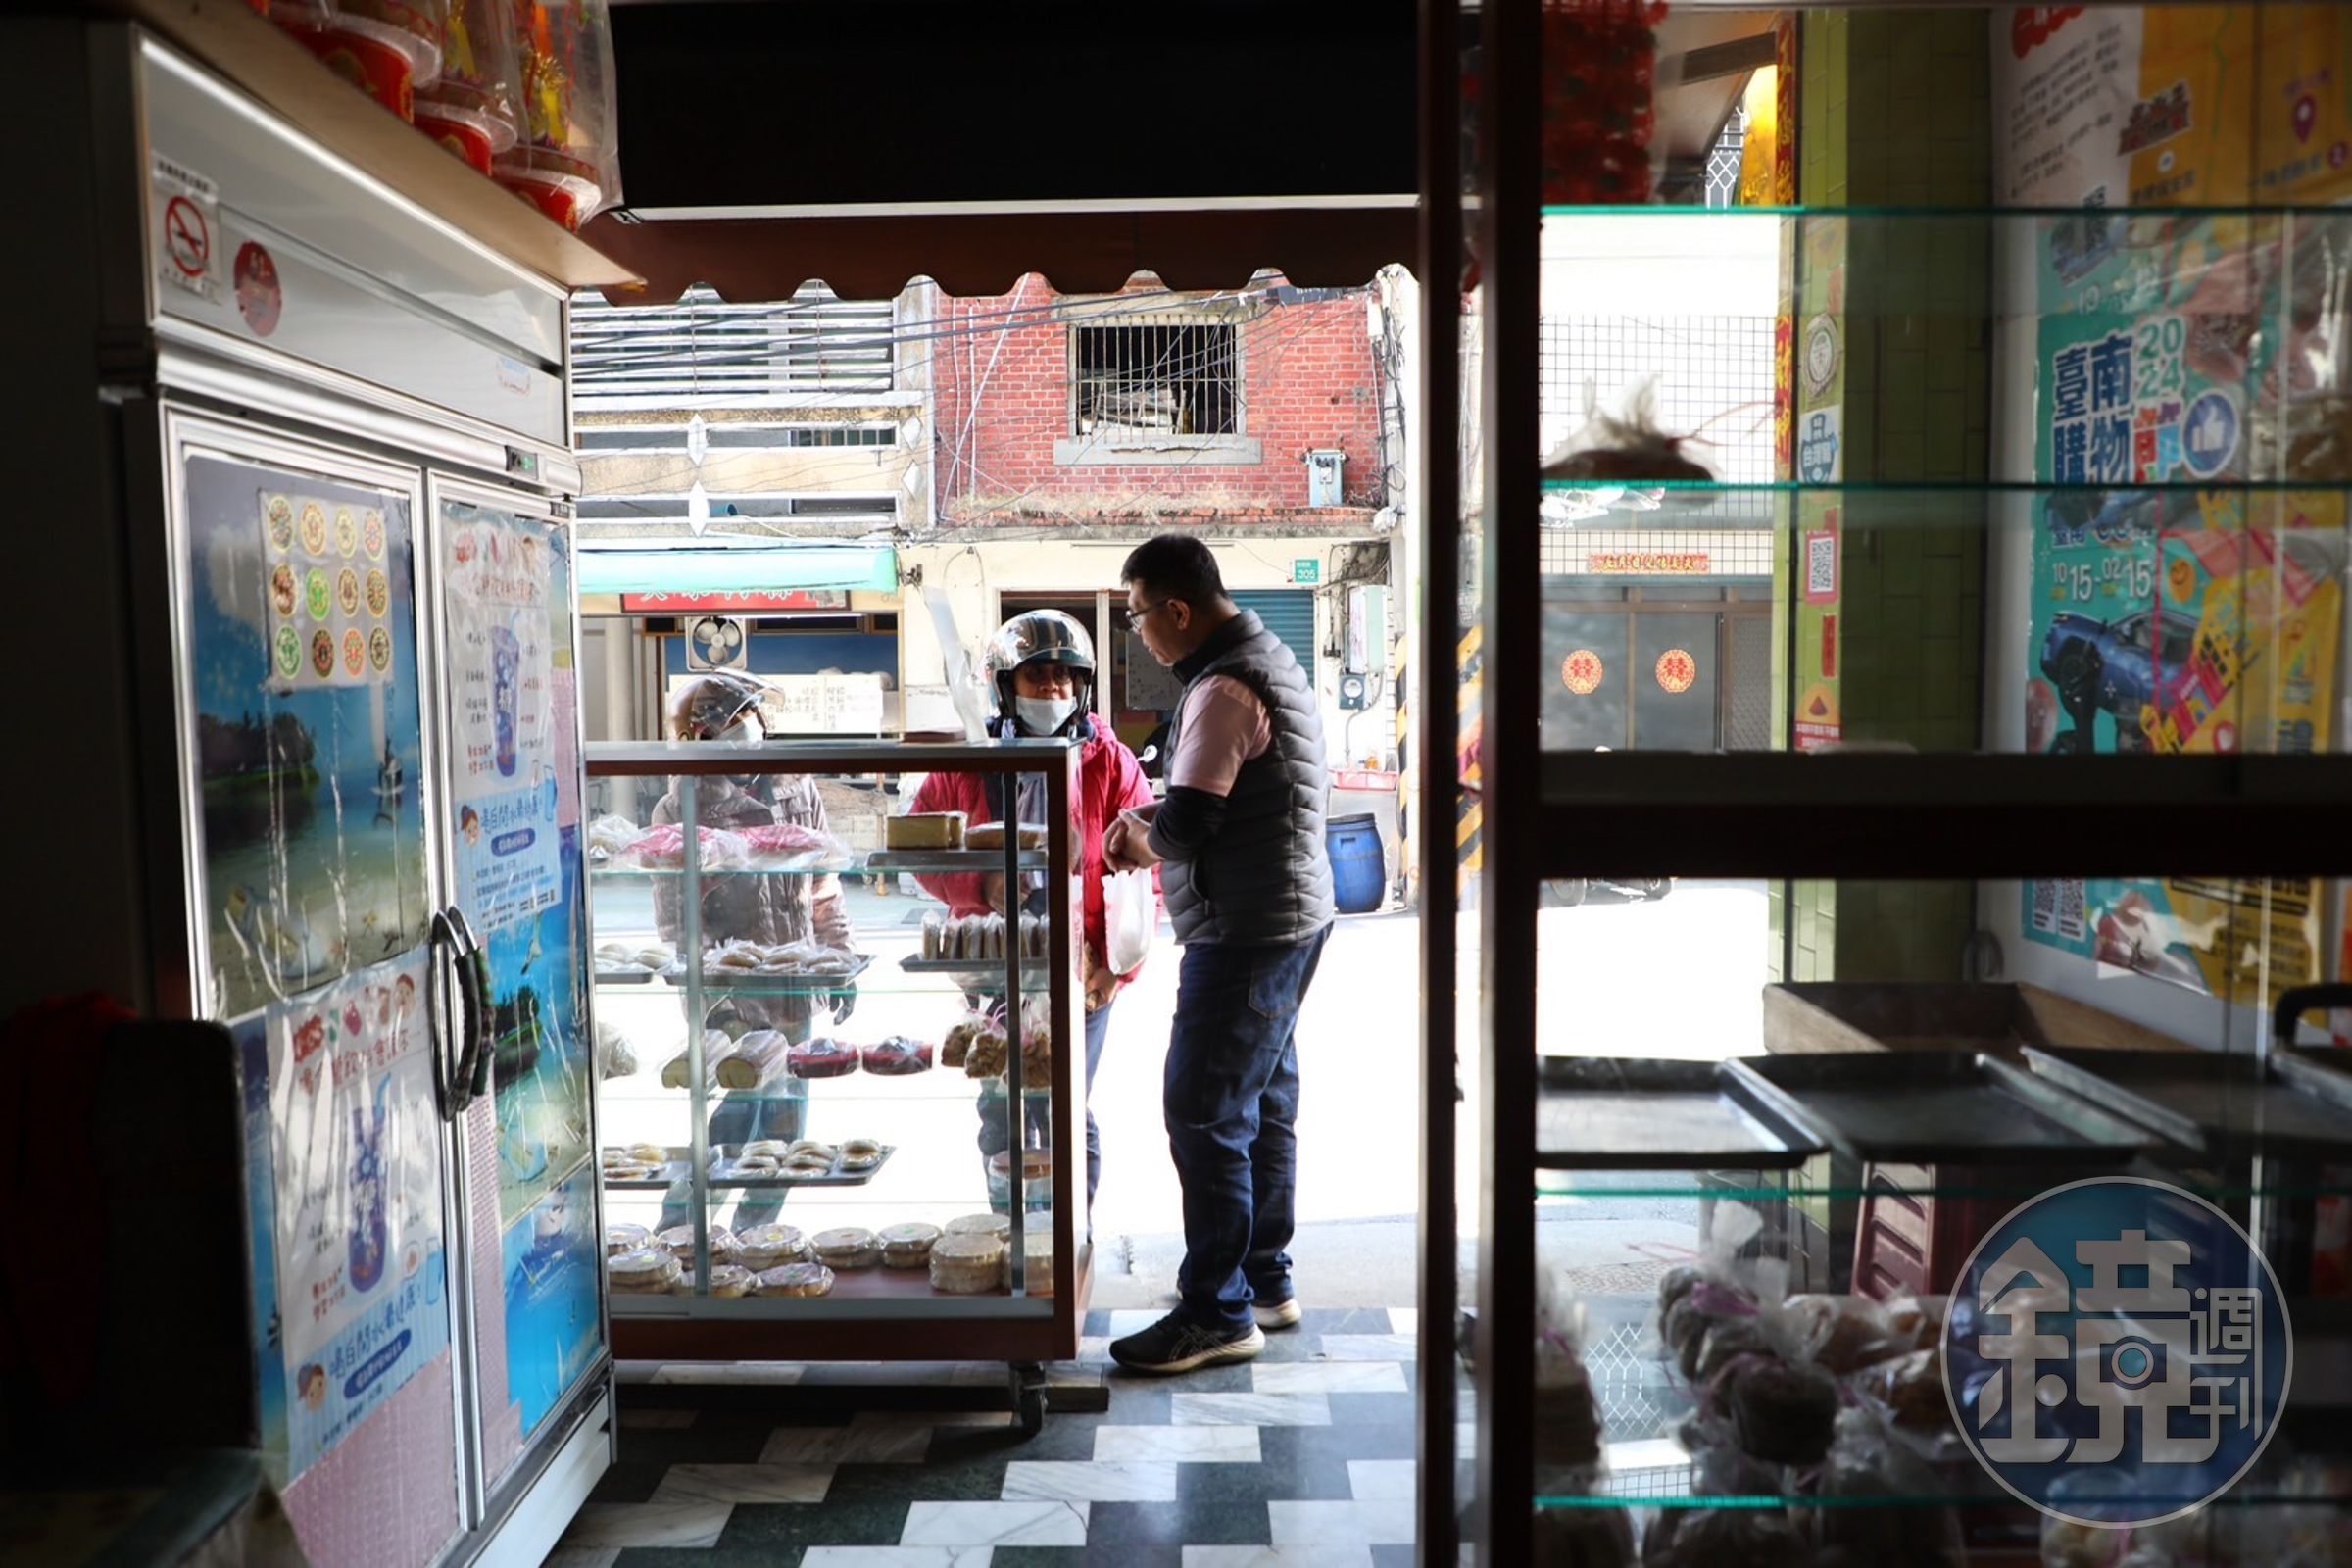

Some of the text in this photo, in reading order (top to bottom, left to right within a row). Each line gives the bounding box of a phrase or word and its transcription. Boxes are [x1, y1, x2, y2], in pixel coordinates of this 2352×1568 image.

[2053, 334, 2134, 422] 臺南
[1298, 569, 1316, 580] 305
[2069, 564, 2093, 601] 15
[2123, 559, 2152, 599] 15
